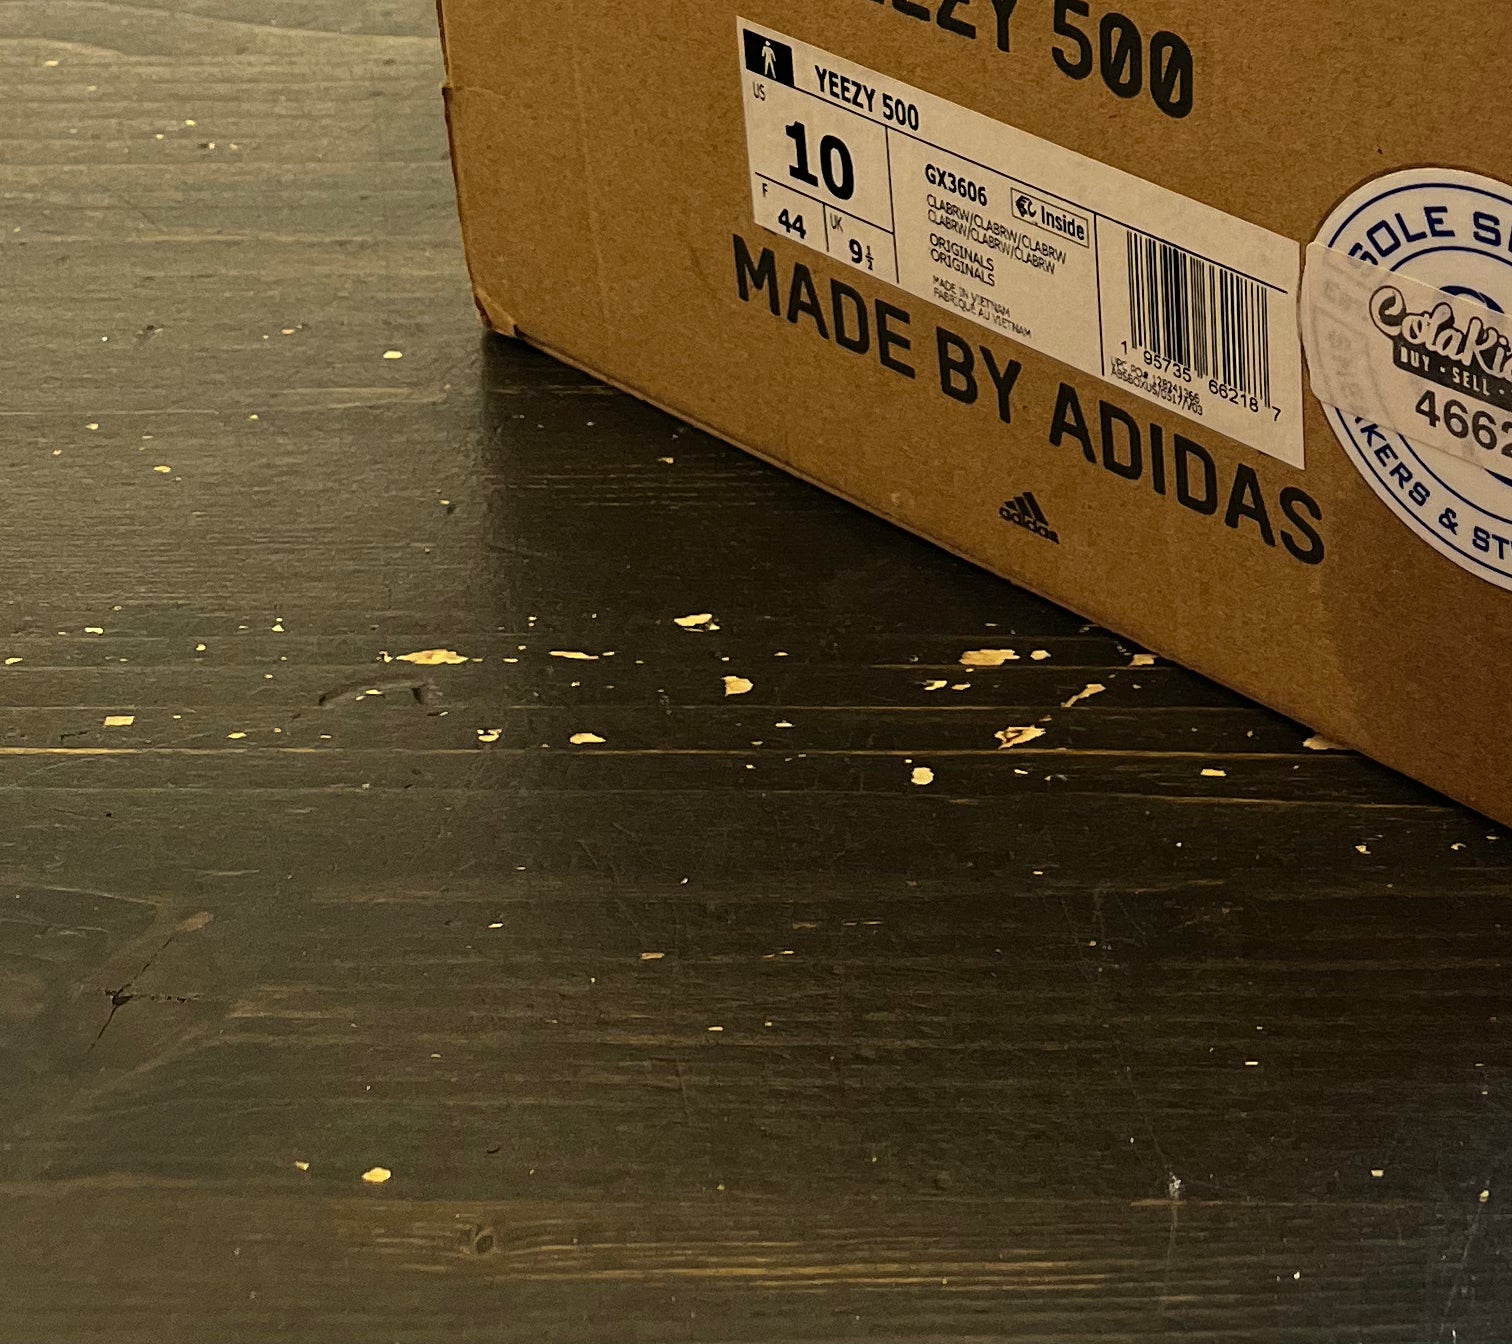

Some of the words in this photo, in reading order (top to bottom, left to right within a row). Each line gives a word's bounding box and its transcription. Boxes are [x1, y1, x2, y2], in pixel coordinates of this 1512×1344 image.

[752, 81, 766, 101] US
[814, 64, 876, 112] YEEZY
[882, 93, 919, 131] 500
[785, 120, 855, 201] 10
[762, 182, 768, 197] F
[925, 163, 988, 207] GX3606
[777, 208, 806, 240] 44
[830, 212, 844, 232] UK
[1041, 204, 1085, 240] Inside
[929, 232, 995, 272] ORIGINALS
[931, 248, 996, 287] ORIGINALS
[1120, 340, 1127, 355] 1
[1143, 350, 1193, 383] 95735
[1208, 378, 1259, 413] 66218
[1271, 406, 1281, 422] 7
[1400, 345, 1431, 373] BUY
[1452, 366, 1491, 397] SELL
[731, 233, 915, 379] MADE
[935, 324, 1023, 424] BY
[1048, 381, 1327, 565] ADIDAS
[1439, 507, 1460, 536] &
